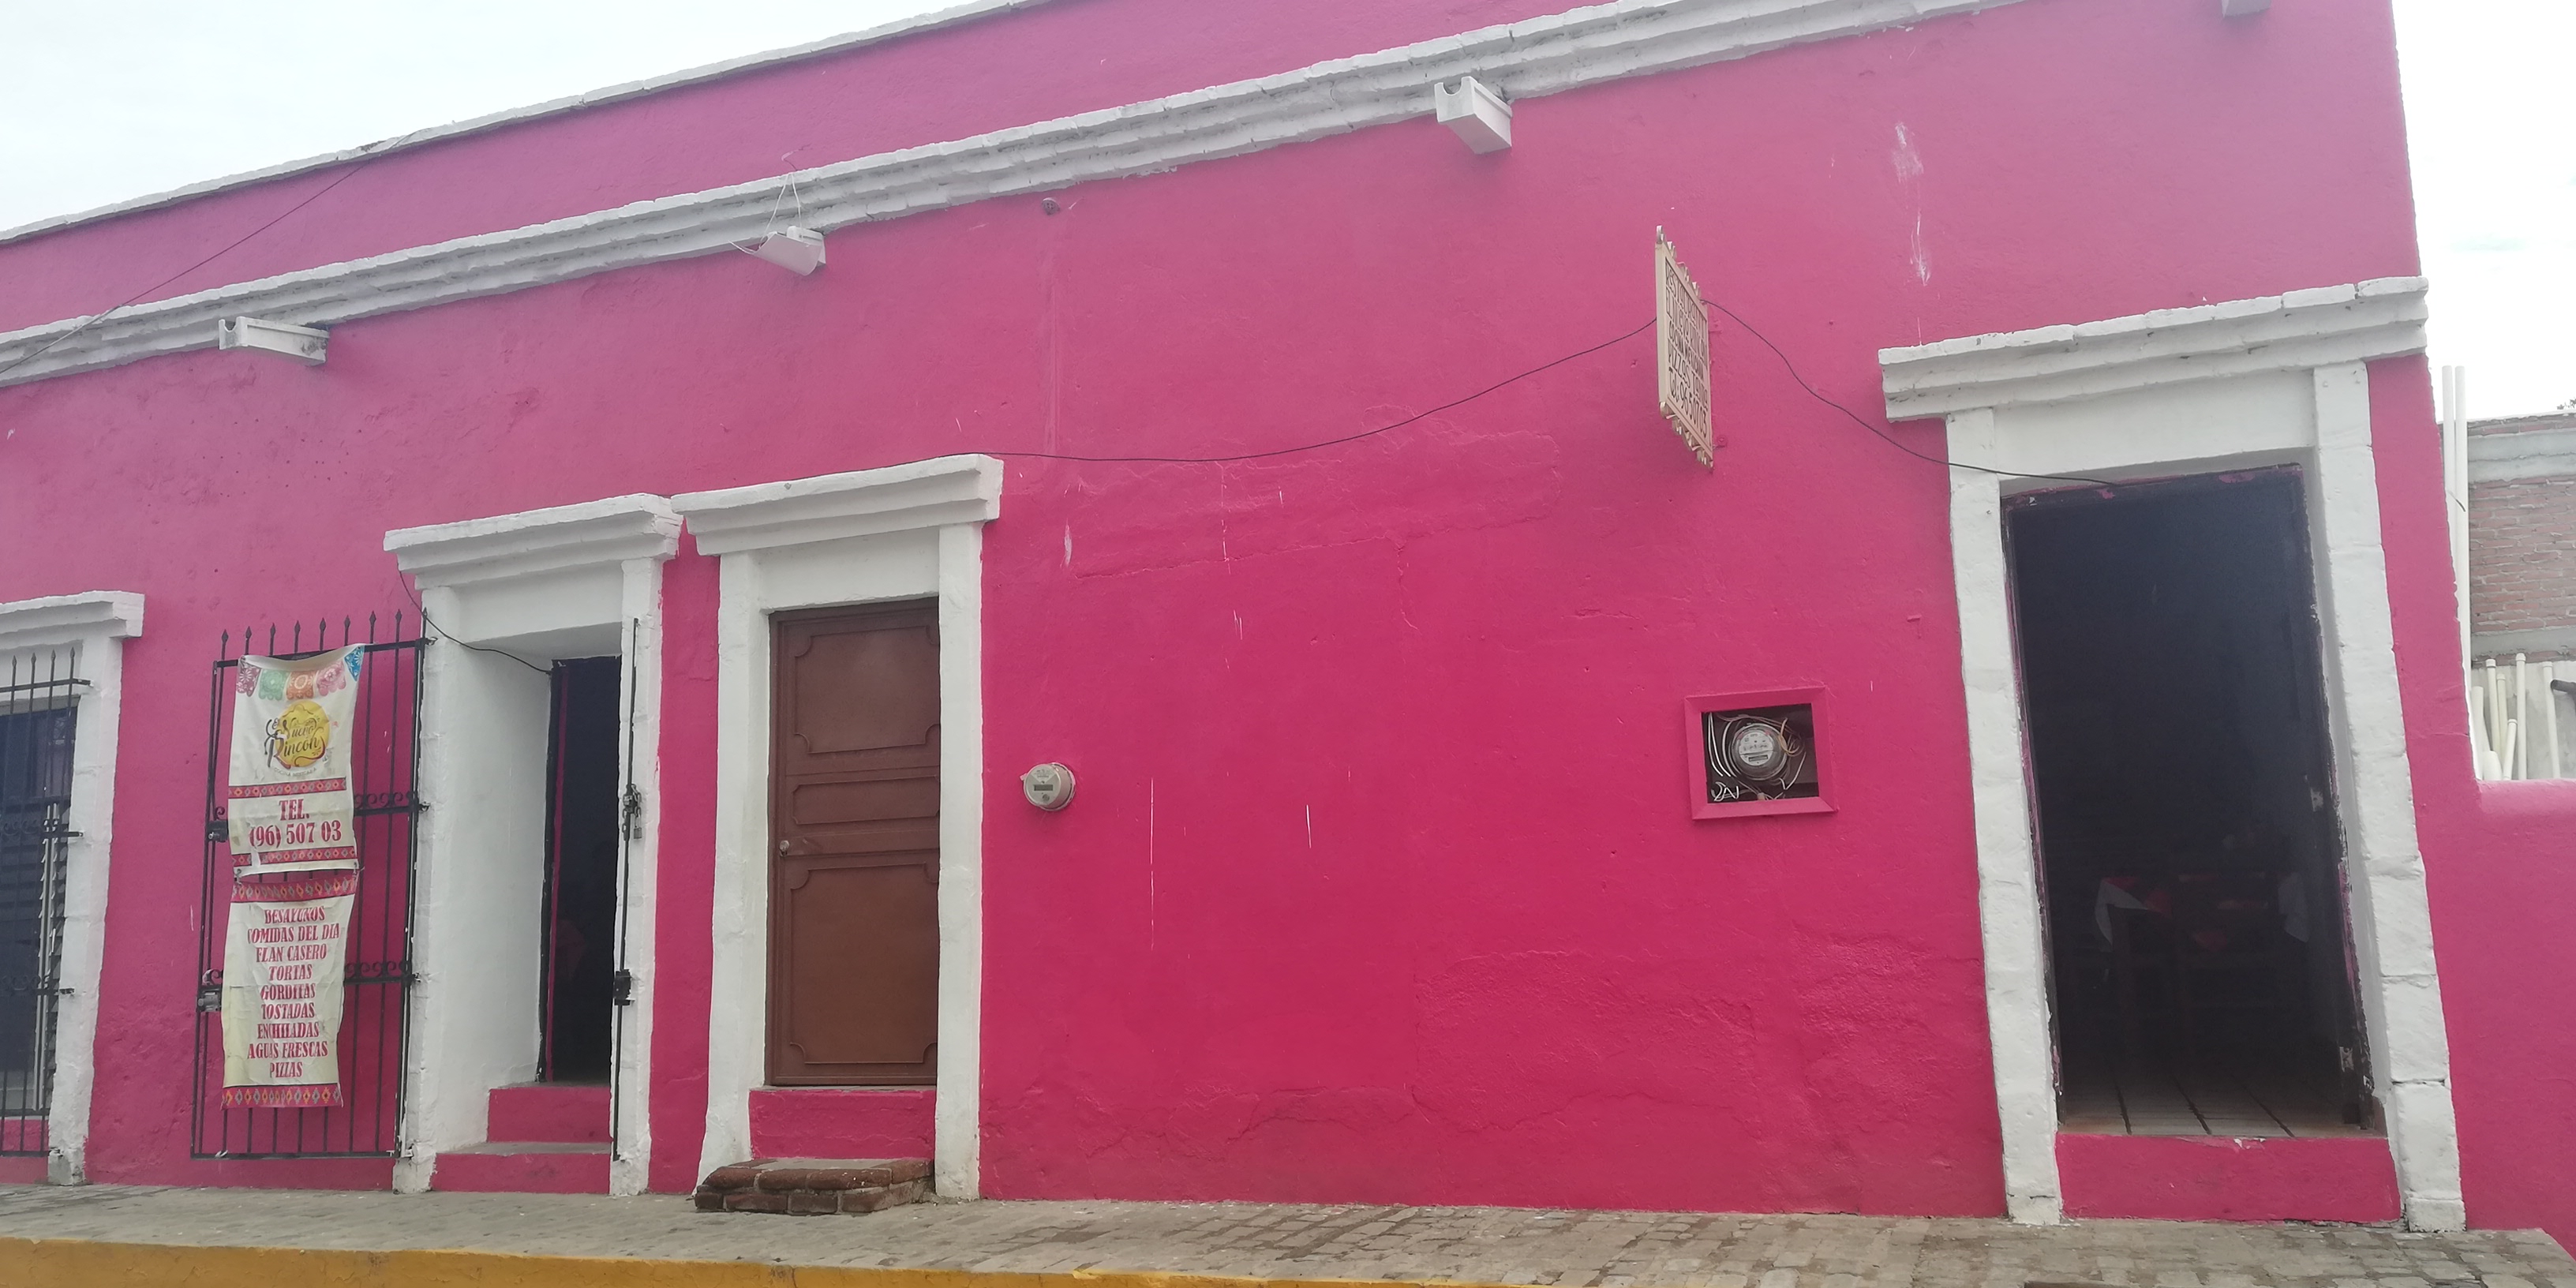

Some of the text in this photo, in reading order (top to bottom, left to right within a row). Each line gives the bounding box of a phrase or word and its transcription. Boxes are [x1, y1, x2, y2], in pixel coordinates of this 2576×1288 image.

[279, 799, 310, 821] TEL.
[249, 820, 342, 849] (96) 507 03
[264, 905, 325, 924] DESAYUNOS
[298, 925, 319, 942] DEL
[321, 923, 339, 940] DIA
[256, 943, 327, 963] FLAN CASERO
[268, 964, 313, 981] TORTAS
[260, 983, 316, 1001] GORDITAS
[247, 1041, 328, 1059] AGUAS FRESCAS
[270, 1061, 303, 1078] PIZZAS
